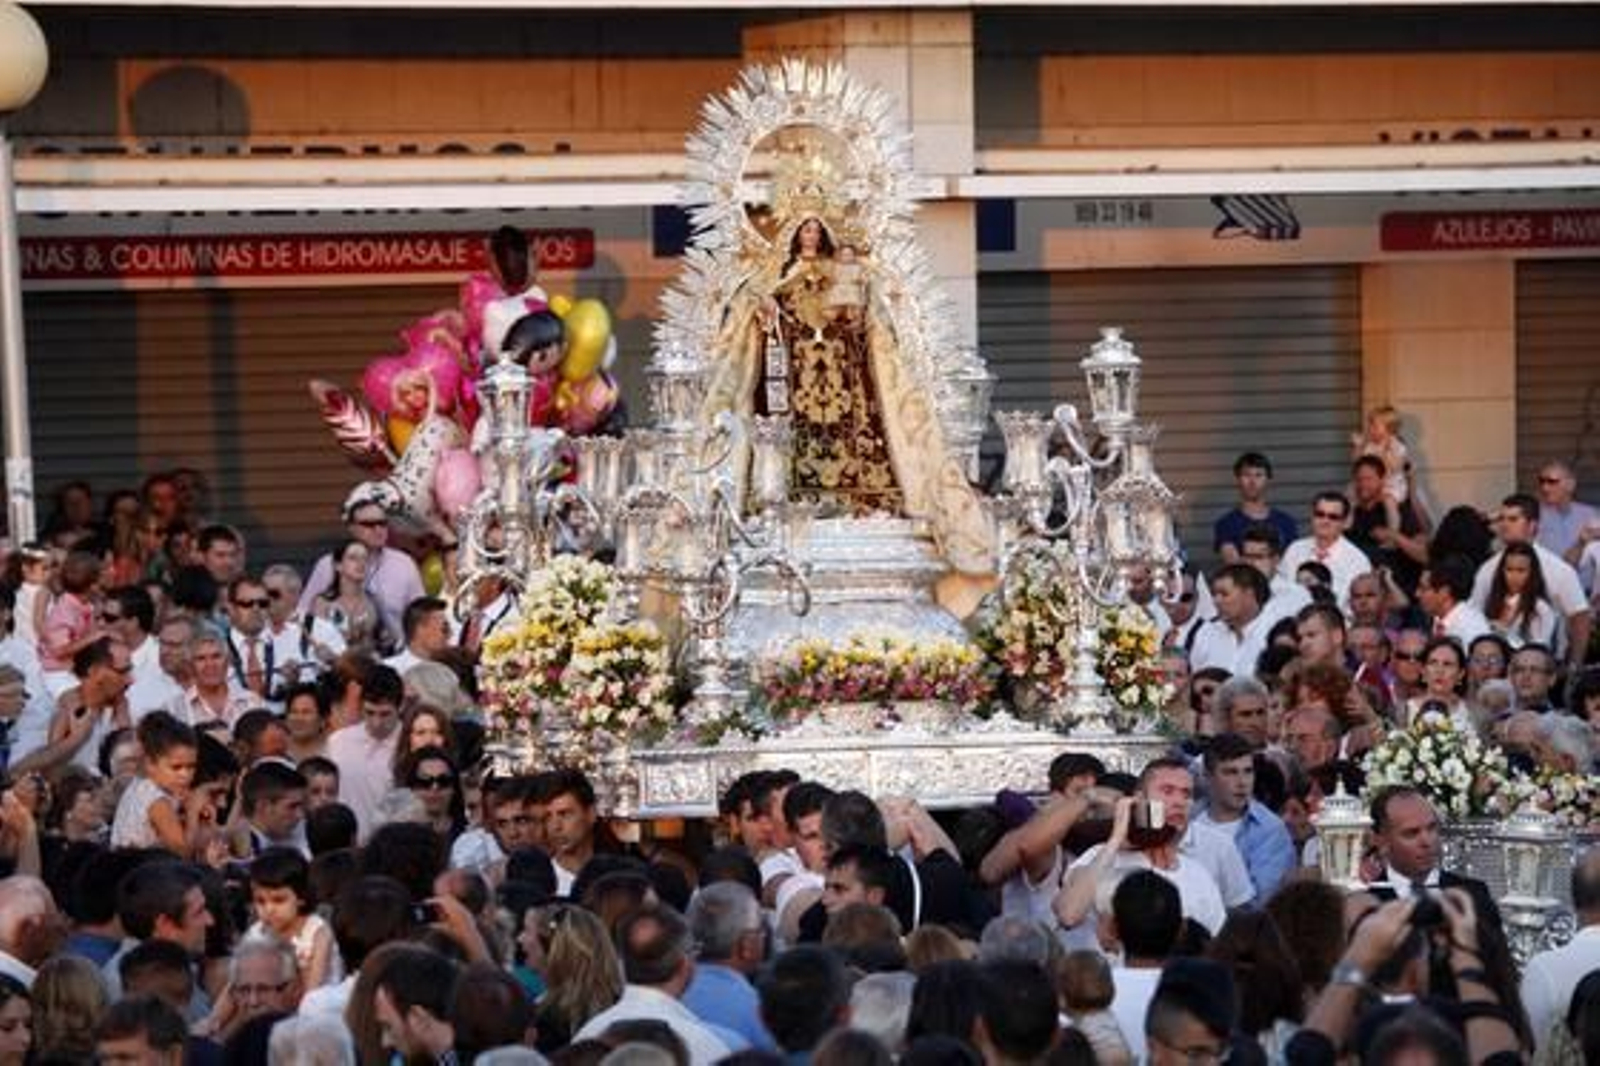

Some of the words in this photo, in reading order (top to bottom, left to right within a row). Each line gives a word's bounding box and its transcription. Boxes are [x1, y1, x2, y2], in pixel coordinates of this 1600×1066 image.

[1431, 217, 1532, 244] AZULEJOS
[84, 244, 103, 271] &
[110, 242, 253, 271] COLUMNAS
[261, 242, 292, 268] DE
[300, 238, 468, 267] HIDROMASAJE
